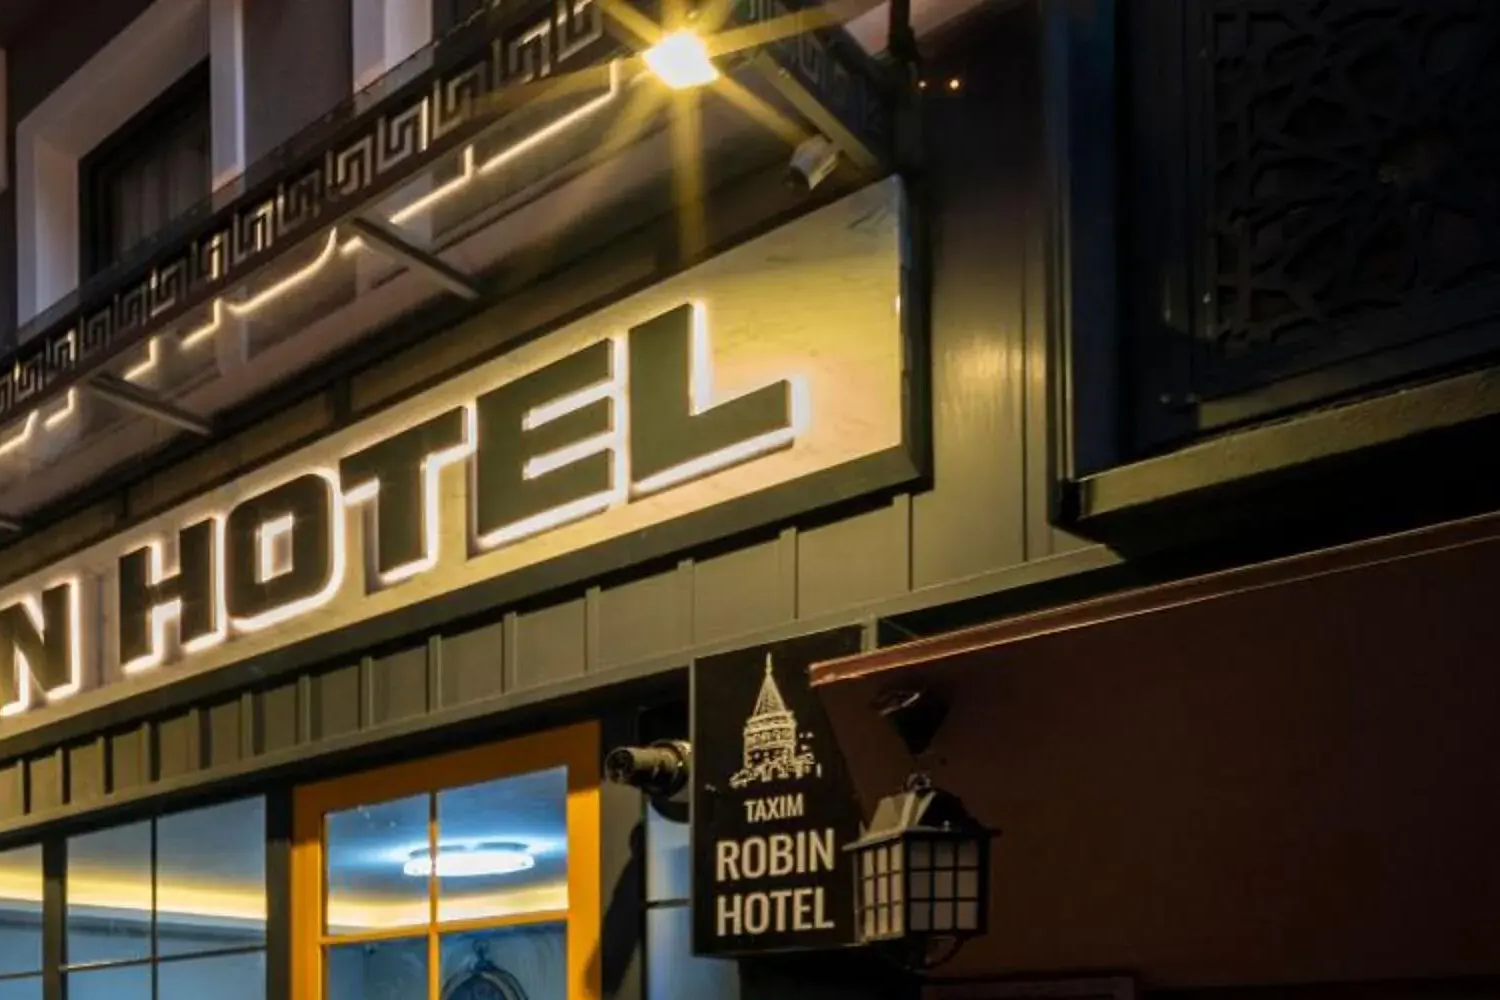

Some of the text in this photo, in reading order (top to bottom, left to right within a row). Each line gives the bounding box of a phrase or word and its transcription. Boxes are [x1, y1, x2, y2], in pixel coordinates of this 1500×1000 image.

[118, 302, 792, 666] HOTEL
[744, 793, 804, 823] TAXIM
[715, 828, 835, 882] ROBIN
[716, 886, 835, 937] HOTEL
